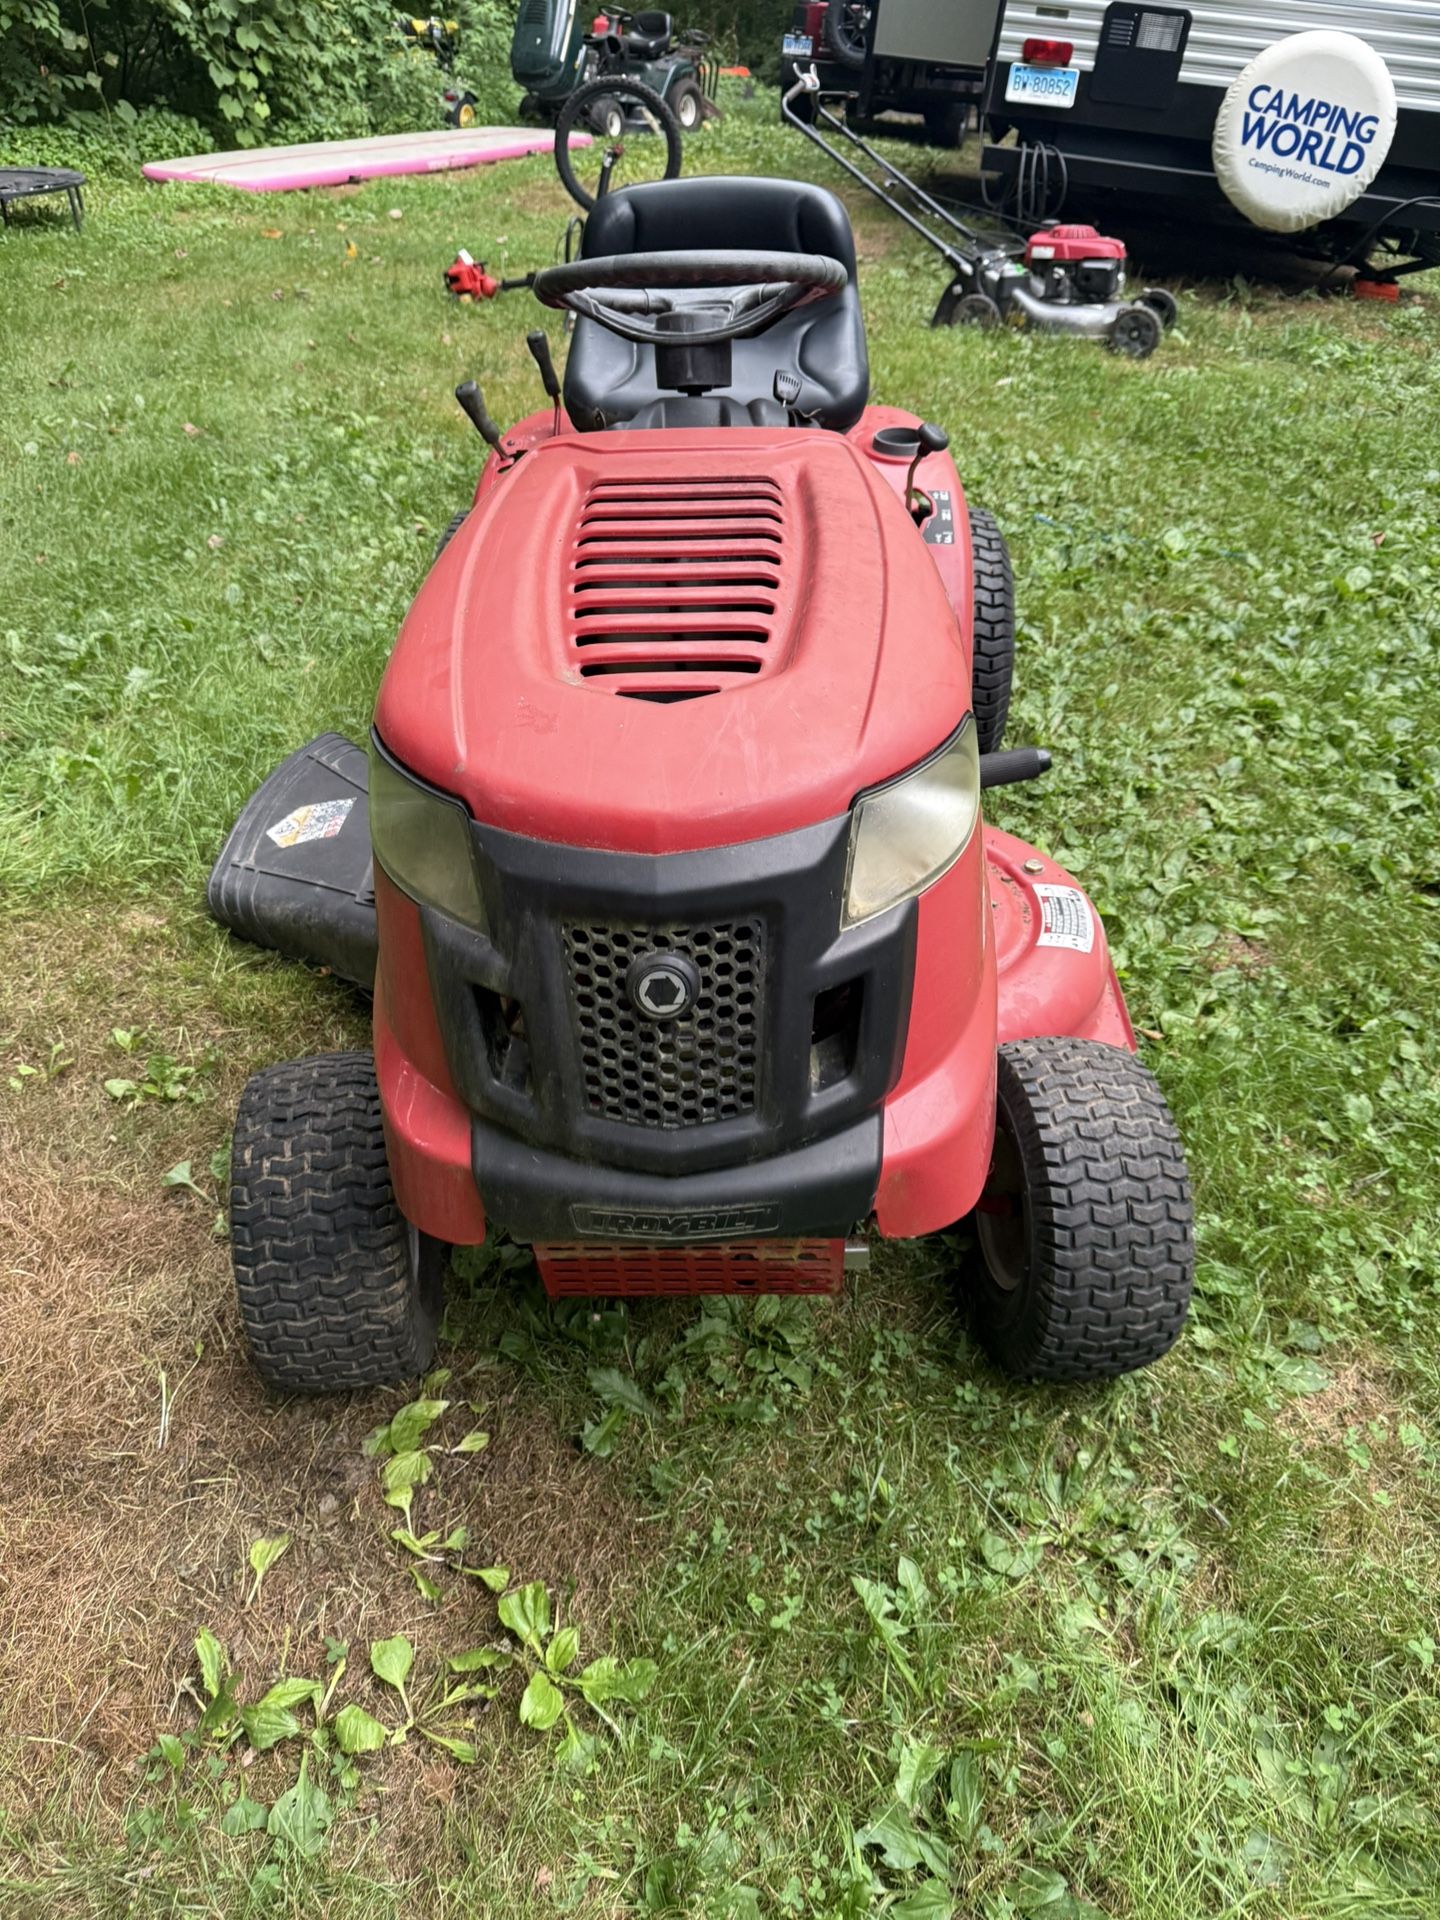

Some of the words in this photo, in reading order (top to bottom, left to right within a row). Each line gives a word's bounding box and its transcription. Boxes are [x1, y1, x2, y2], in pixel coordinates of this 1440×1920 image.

[1241, 111, 1365, 175] WORLD
[1248, 84, 1380, 144] CAMPING
[1248, 157, 1331, 189] CampingWorld.com
